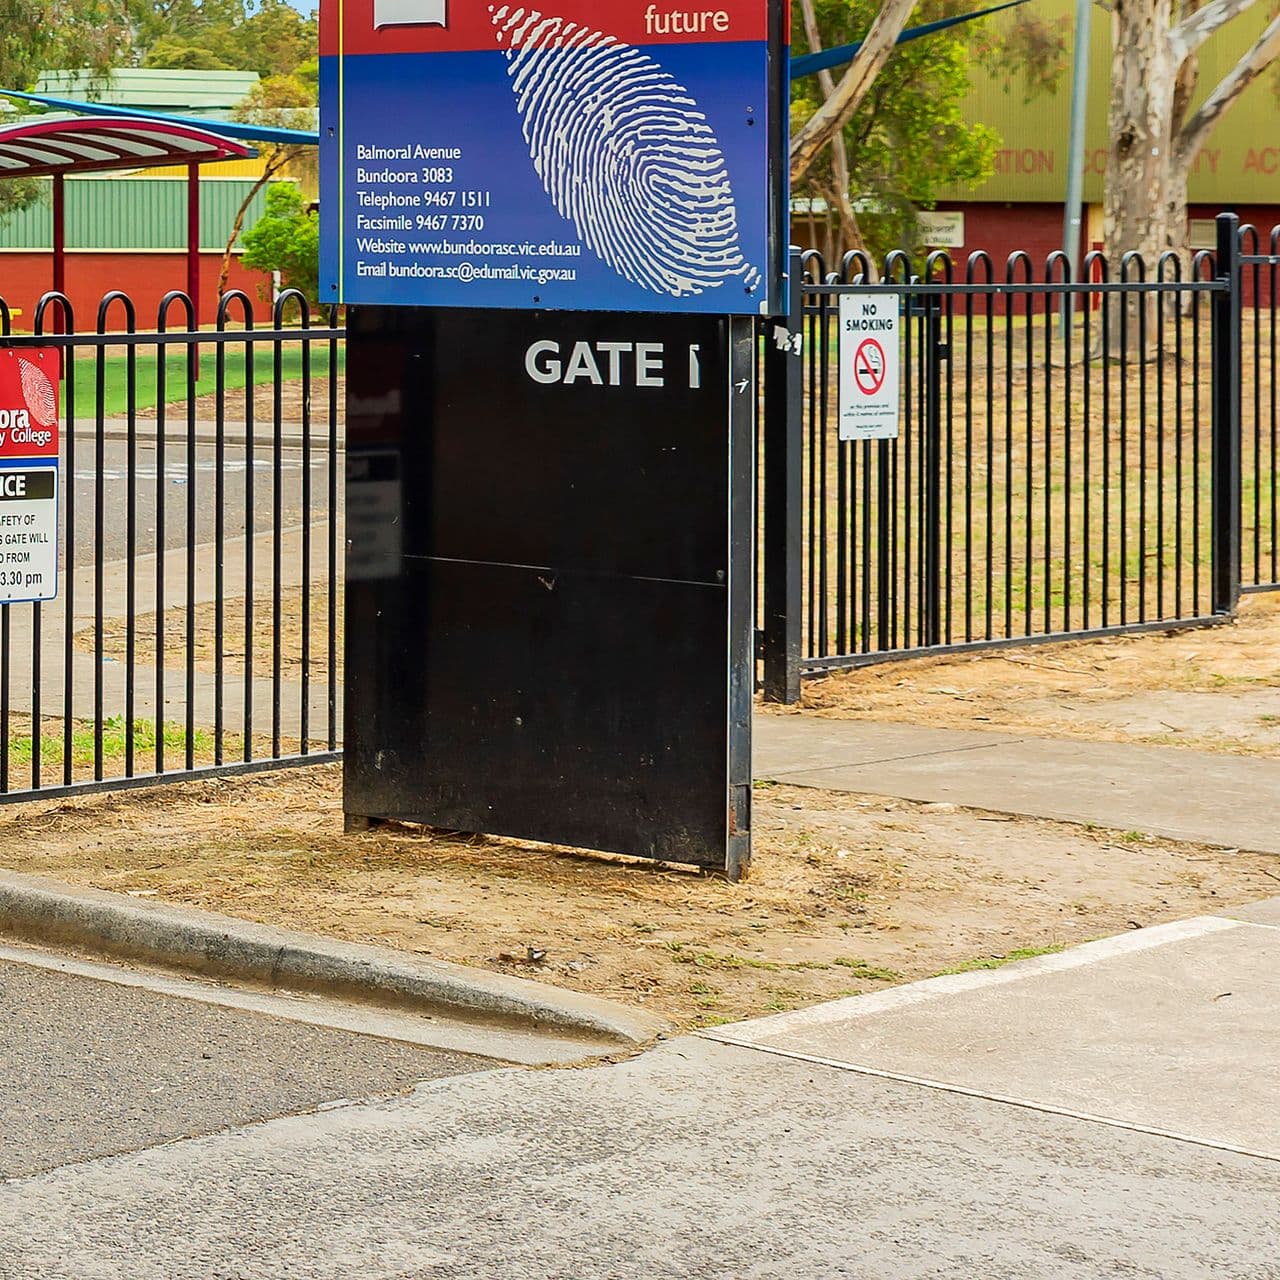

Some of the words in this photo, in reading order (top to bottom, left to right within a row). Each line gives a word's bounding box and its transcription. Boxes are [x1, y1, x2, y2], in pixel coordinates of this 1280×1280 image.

[644, 4, 729, 34] future
[357, 144, 412, 160] Balmoral
[412, 143, 462, 160] Avenue
[357, 167, 419, 183] Bundoora
[421, 167, 453, 183] 3083
[356, 191, 421, 211] Telephone
[423, 190, 457, 207] 9467
[461, 191, 490, 207] 1511
[356, 214, 413, 230] Facsimile
[415, 214, 448, 231] 9467
[451, 214, 484, 231] 7370
[356, 237, 406, 254] Website
[408, 238, 581, 257] www.bundoorasc.vic.edu.au
[356, 260, 387, 277] Email
[388, 261, 576, 285] bundoora.sc@edumail.vic.gov.au
[862, 303, 877, 316] NO
[846, 318, 894, 332] SMOKING
[524, 339, 665, 387] GATE
[11, 428, 52, 447] College
[23, 514, 36, 526] OF
[4, 533, 27, 545] GATE
[28, 532, 49, 544] WILL
[6, 551, 30, 564] FROM
[0, 570, 23, 586] 3.30
[25, 572, 43, 589] pm
